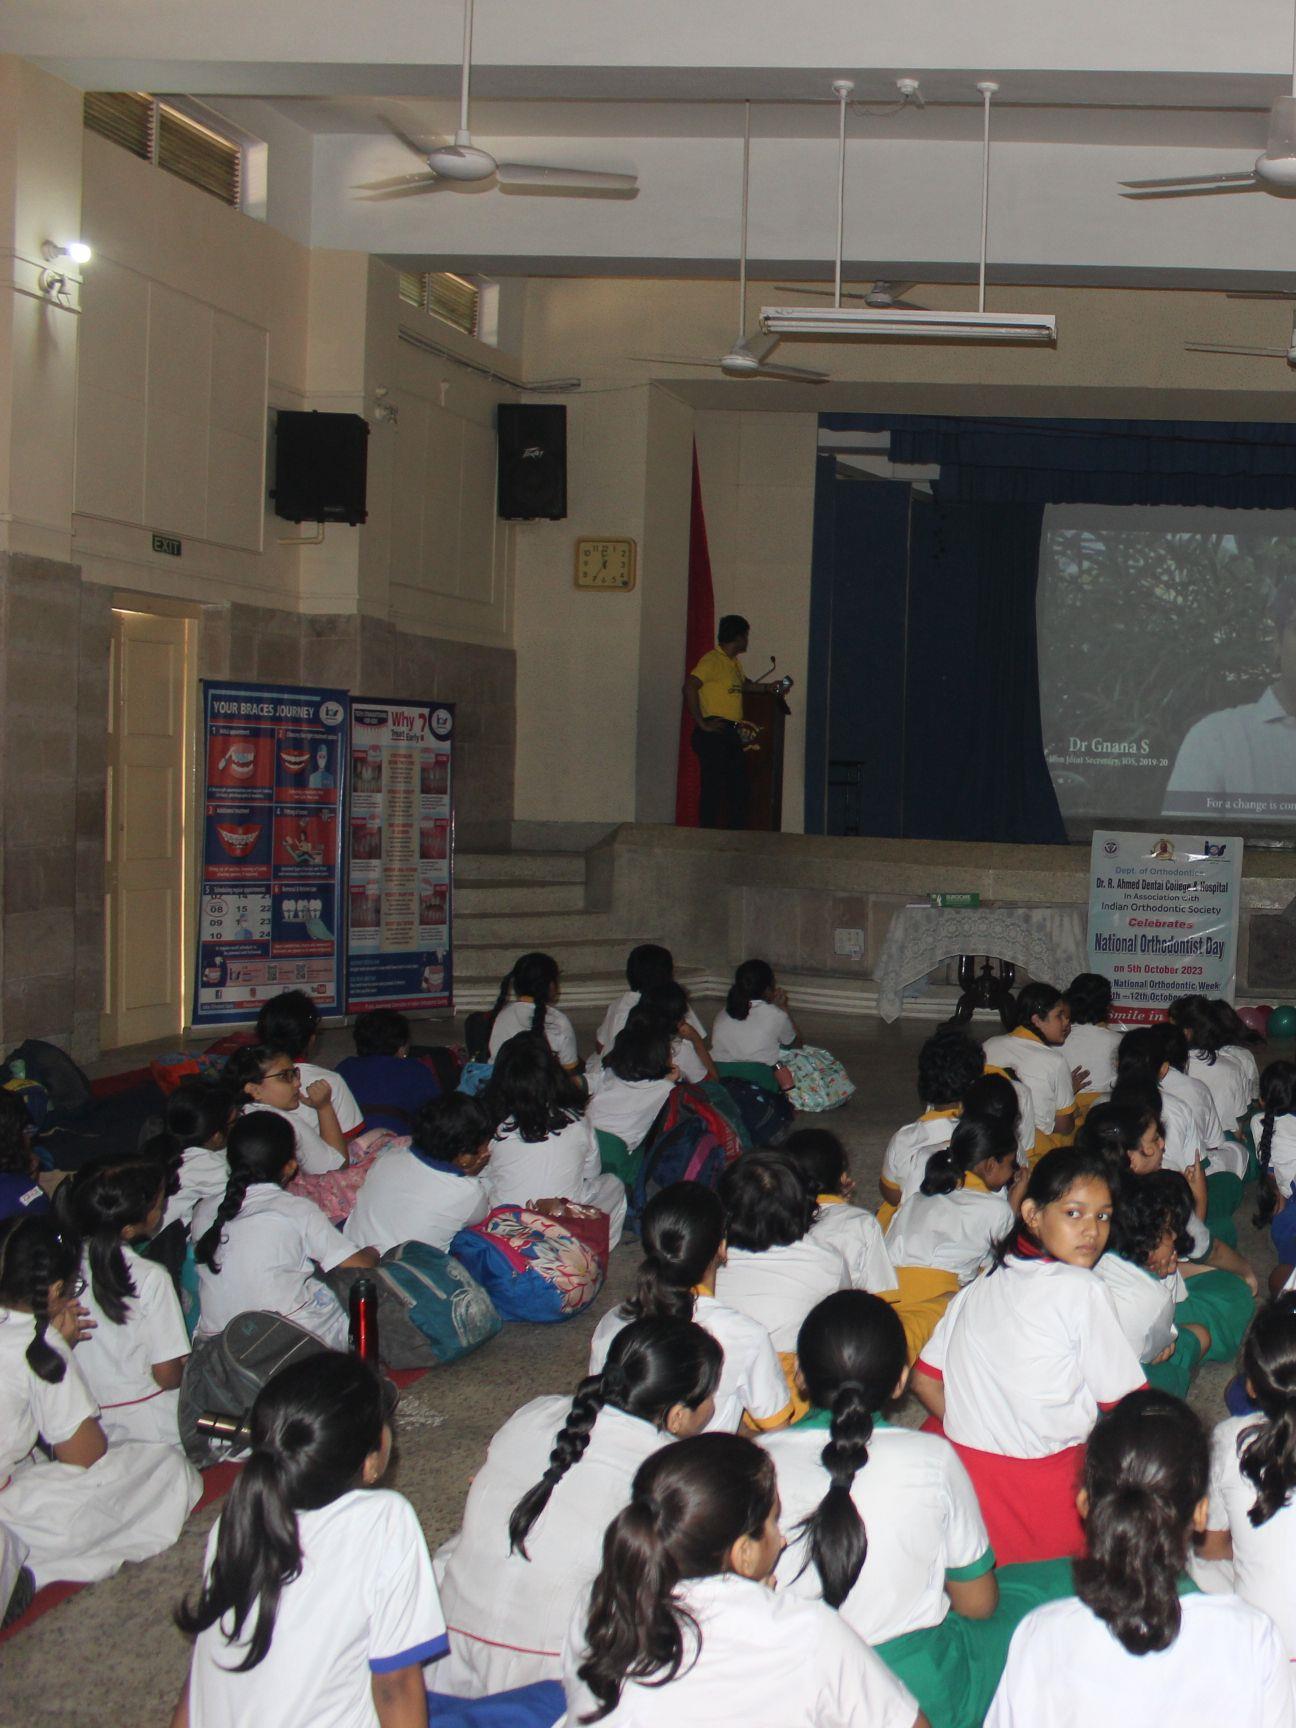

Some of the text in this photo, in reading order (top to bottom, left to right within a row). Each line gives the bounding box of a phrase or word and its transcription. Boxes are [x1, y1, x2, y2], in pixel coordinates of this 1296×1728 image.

[155, 537, 179, 554] EXIT
[213, 701, 315, 719] YOUR BRACES JOURNEY
[392, 711, 415, 731] Why
[1069, 737, 1150, 754] Dr Gnana S
[1139, 758, 1168, 767] 2019-20
[1206, 797, 1223, 807] For
[1225, 799, 1230, 807] a
[1233, 798, 1267, 812] change
[1269, 799, 1277, 809] is
[1115, 866, 1136, 876] Dept.
[1140, 867, 1147, 875] of
[1096, 878, 1106, 889] Dr.
[1108, 878, 1115, 889] R.
[1117, 878, 1140, 890] Ahmed
[1141, 879, 1164, 890] Dental
[1165, 880, 1191, 893] College
[1199, 881, 1229, 895] Hospital
[1133, 893, 1180, 901] Association
[1182, 894, 1200, 902] with
[210, 906, 223, 914] 08
[1101, 902, 1222, 916] Indian Orthodontic Society
[210, 919, 223, 927] 09
[1128, 918, 1194, 929] Celebrates
[210, 932, 223, 940] 10
[1094, 932, 1225, 961] National Orthodontist Day
[1128, 964, 1142, 973] 5th
[1144, 965, 1178, 974] October
[1181, 966, 1203, 975] 2023
[1113, 979, 1148, 989] National
[1149, 1010, 1164, 1021] in
